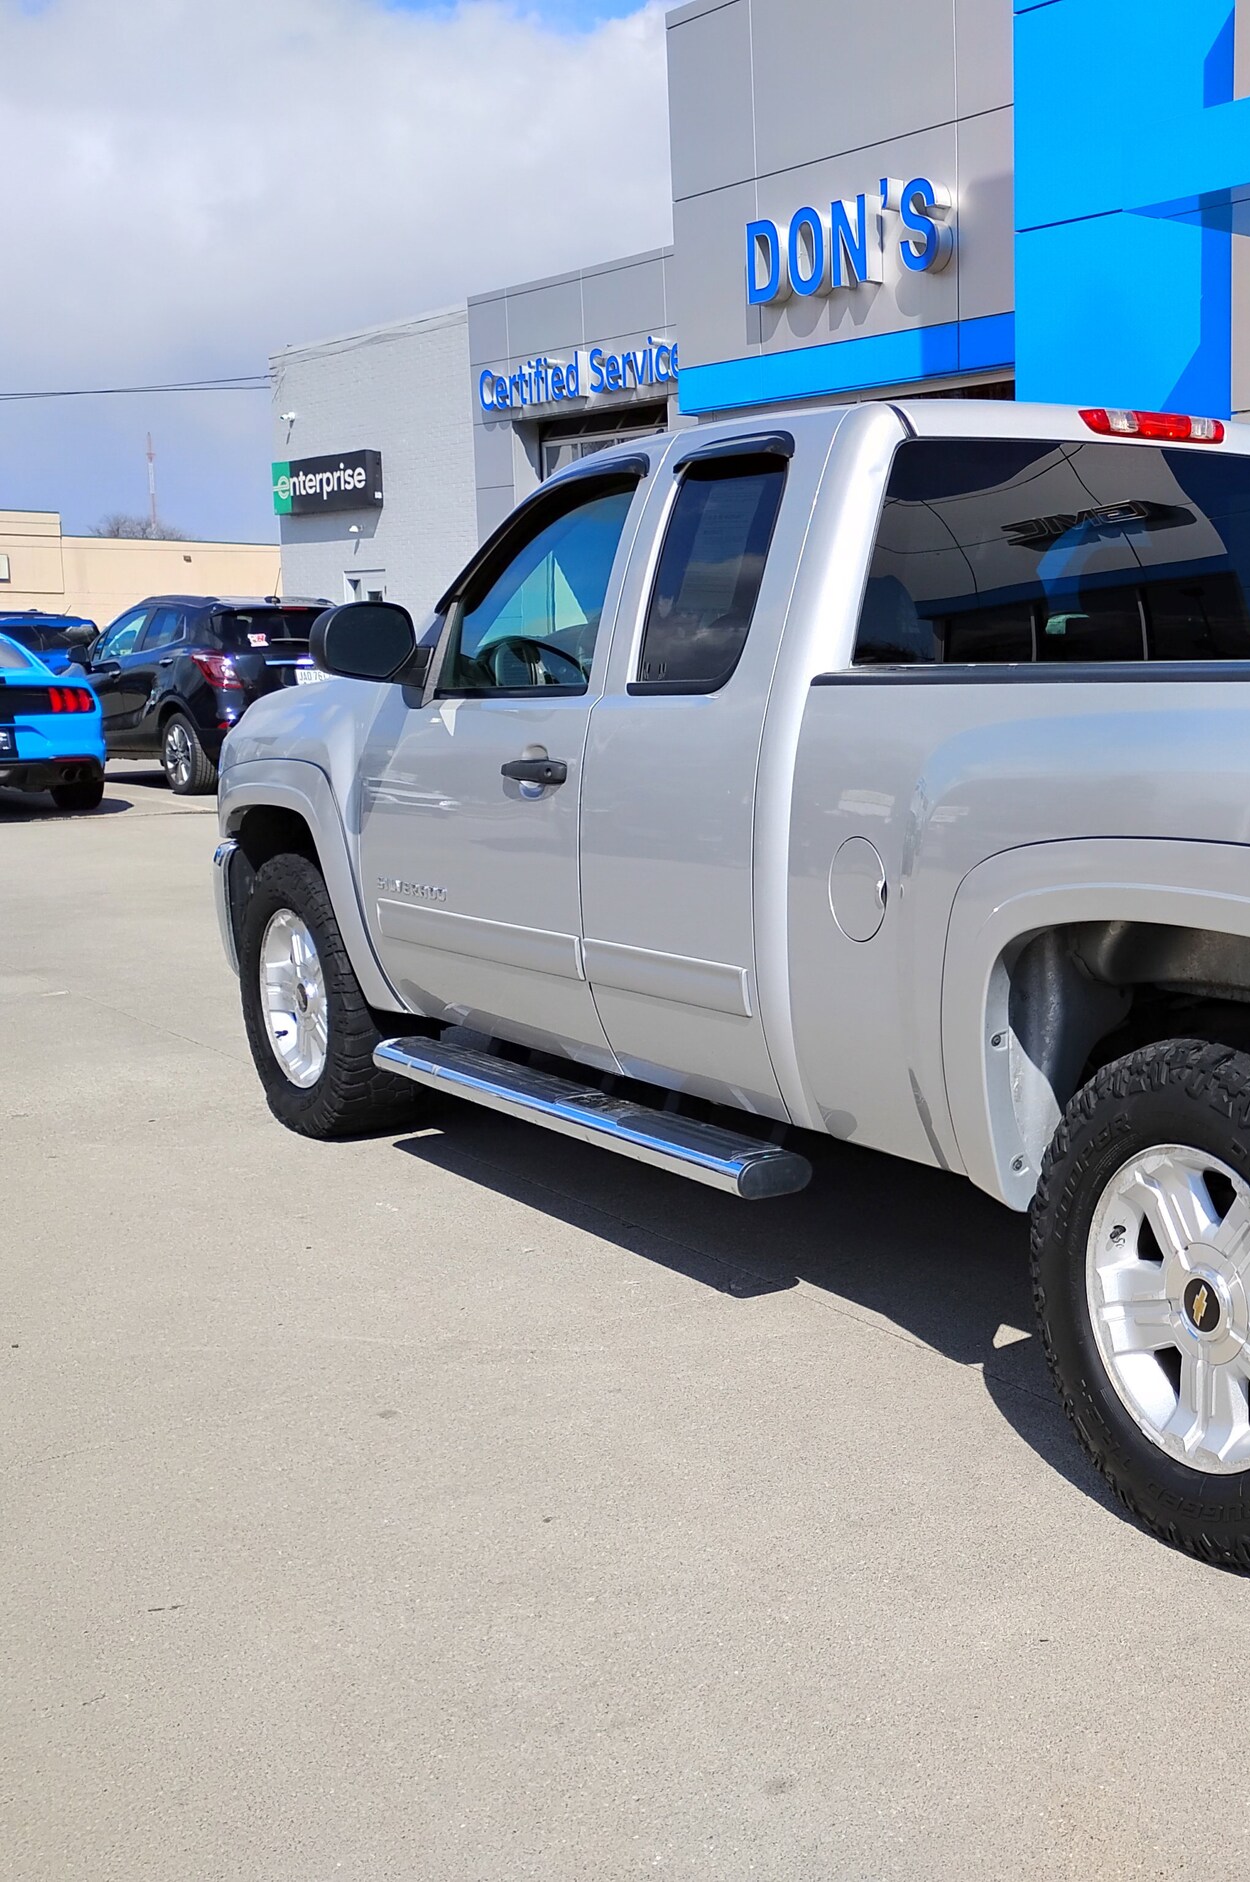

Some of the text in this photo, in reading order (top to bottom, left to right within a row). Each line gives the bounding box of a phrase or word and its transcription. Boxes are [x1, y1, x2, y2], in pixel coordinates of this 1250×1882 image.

[745, 177, 940, 306] DON'S
[479, 351, 583, 412] Certified
[273, 462, 366, 500] enterprise
